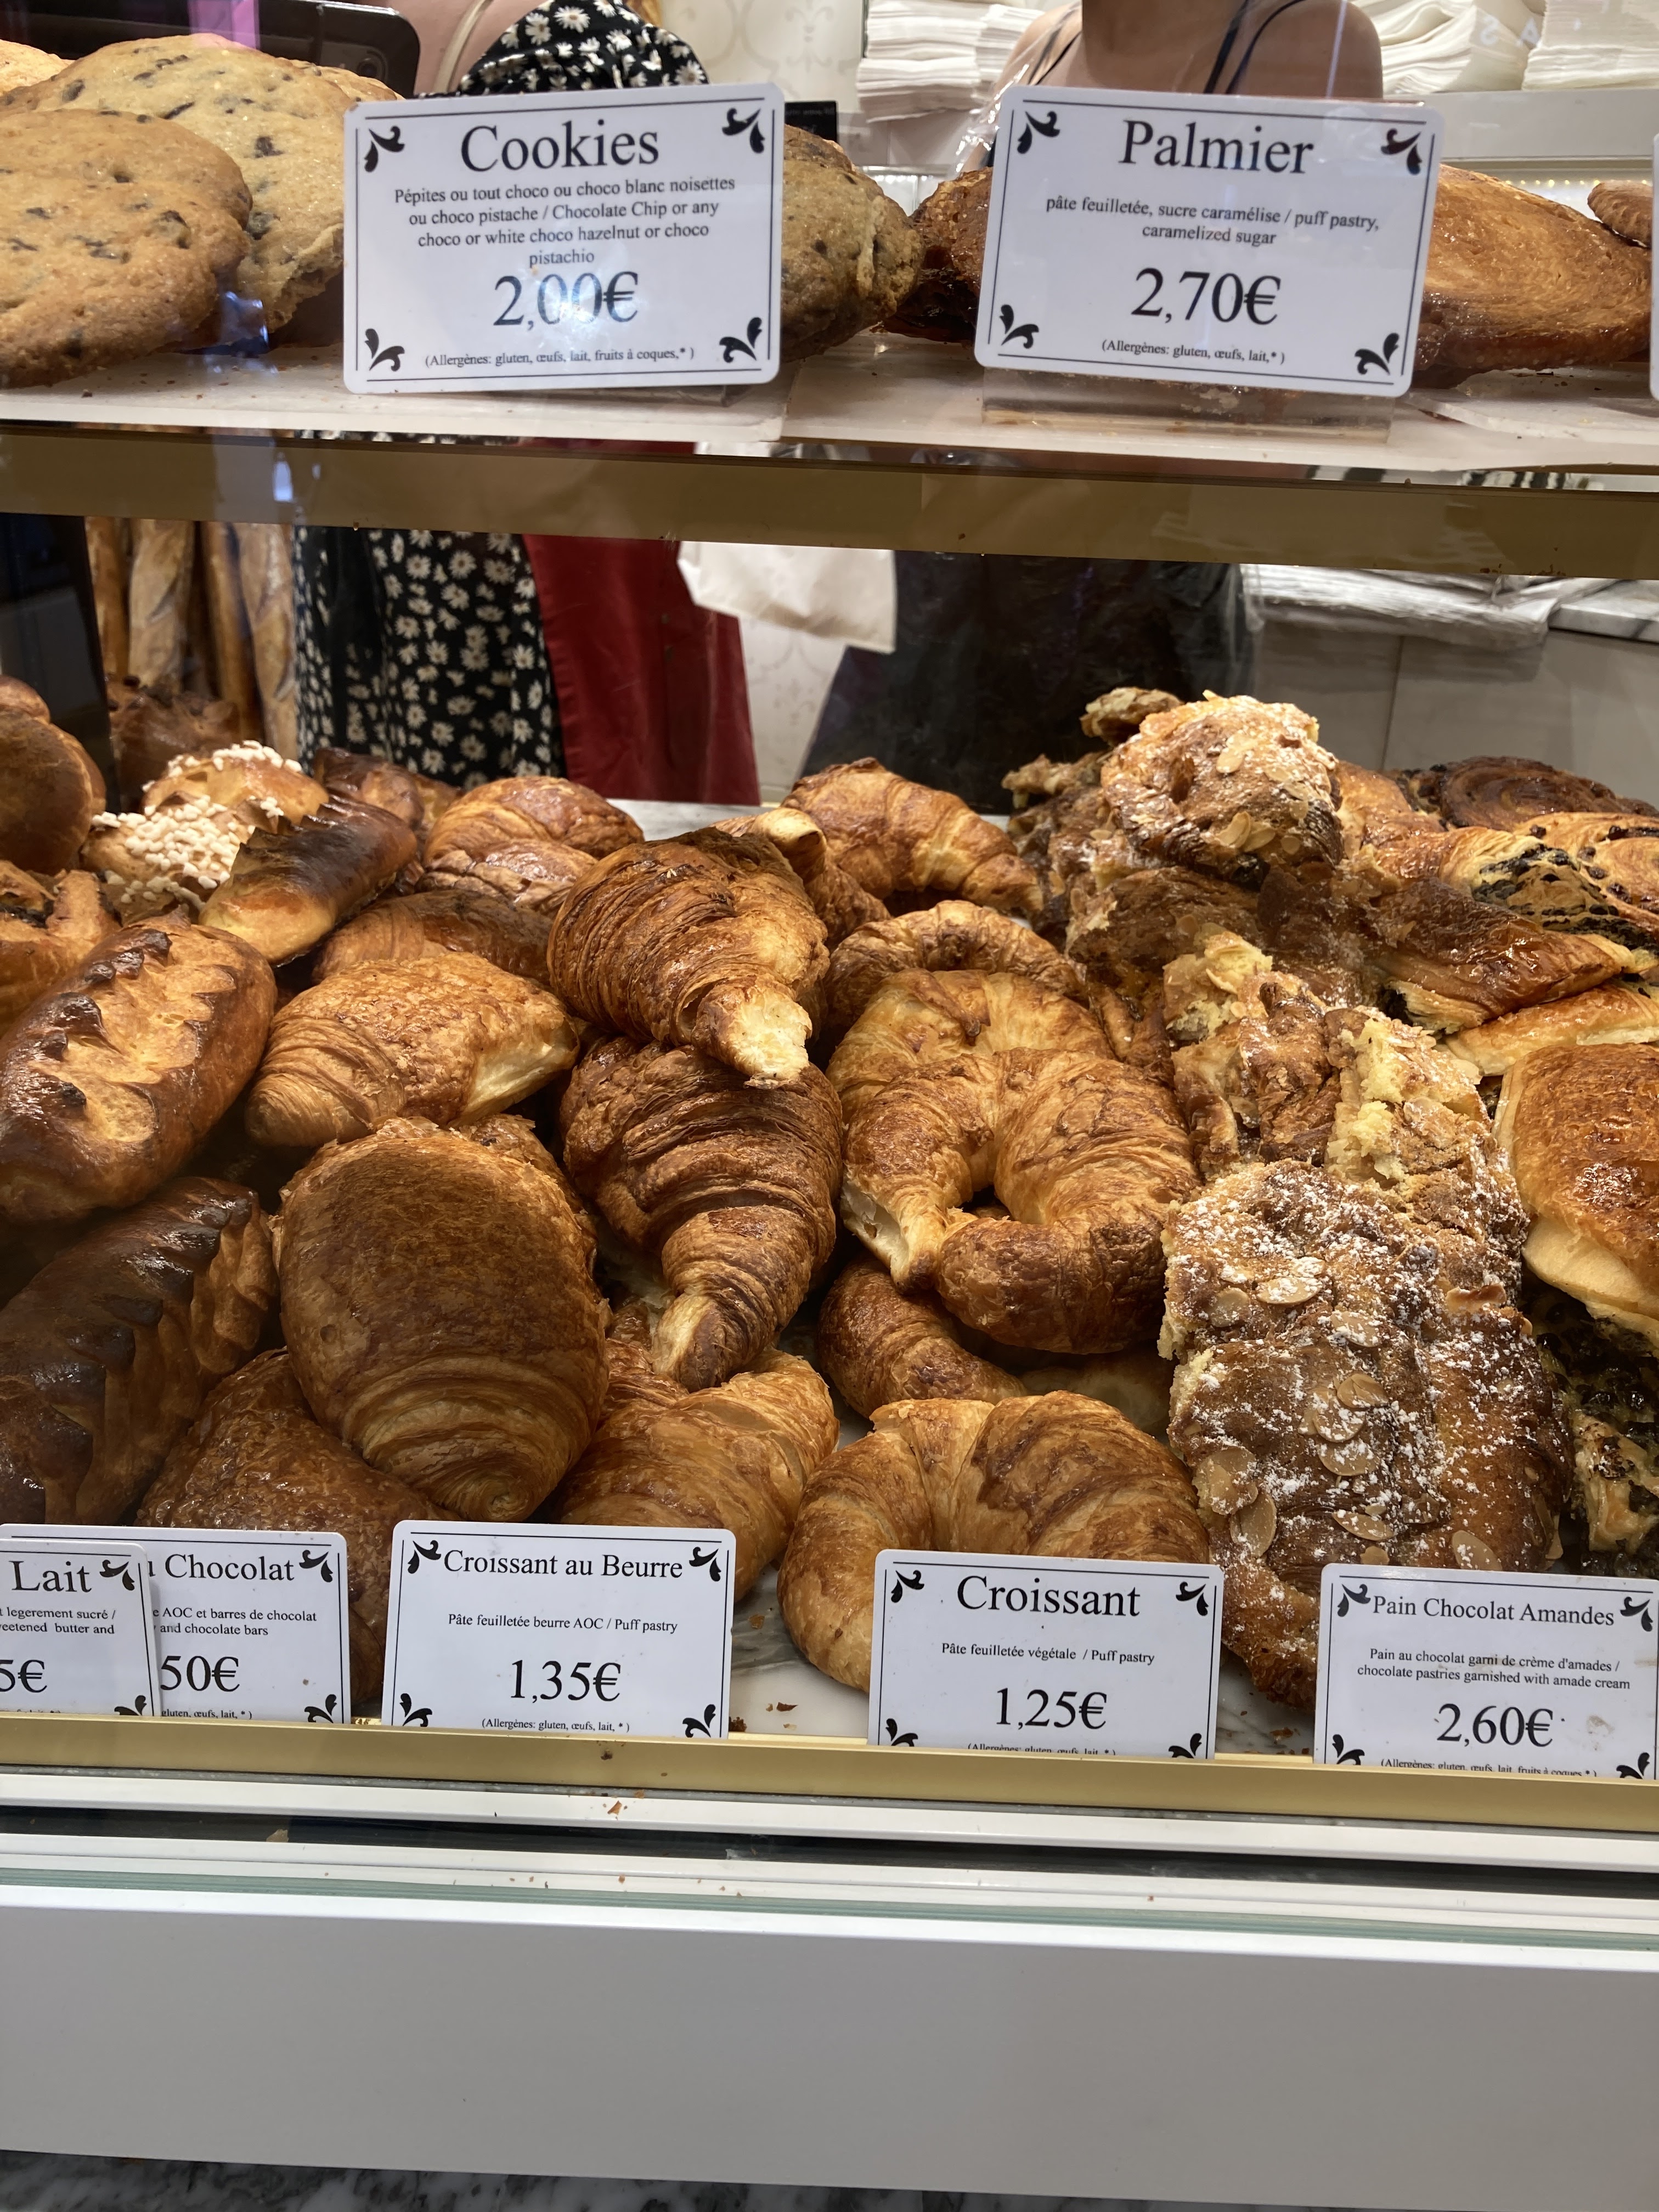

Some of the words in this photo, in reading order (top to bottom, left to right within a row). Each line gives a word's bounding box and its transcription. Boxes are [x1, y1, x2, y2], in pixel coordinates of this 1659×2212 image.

[461, 119, 658, 172] Cookies
[1119, 120, 1314, 173] Palmier
[396, 188, 445, 206] Pépites
[450, 191, 467, 201] ou
[473, 188, 500, 200] tout
[506, 184, 549, 199] choco
[554, 187, 571, 197] ou
[577, 181, 620, 196] choco
[625, 179, 664, 194] blanc
[670, 177, 735, 191] noisettes
[409, 215, 426, 225] ou
[432, 210, 474, 224] choco
[479, 207, 538, 226] pistache
[543, 205, 549, 219] /
[552, 203, 627, 219] Chocolate
[631, 201, 667, 218] Chip
[672, 204, 687, 215] or
[692, 203, 719, 217] any
[1047, 195, 1076, 212] pâte
[1082, 197, 1152, 217] feuilletée,
[1159, 206, 1197, 217] sucre
[1201, 207, 1280, 223] caramélise
[1284, 209, 1292, 223] /
[1295, 211, 1329, 227] puff
[1330, 216, 1378, 232] pastry,
[418, 233, 460, 246] choco
[466, 235, 481, 245] or
[485, 229, 524, 244] white
[530, 228, 573, 242] choco
[579, 225, 640, 240] hazelnut
[645, 228, 661, 238] or
[665, 223, 709, 237] choco
[1142, 225, 1231, 241] caramelized
[1236, 233, 1277, 247] sugar
[529, 249, 594, 269] pistachio
[493, 271, 638, 330] 2,00€
[1131, 268, 1280, 325] 2,70€
[426, 354, 491, 368] (Allergènes:
[495, 353, 533, 366] gluten,
[537, 351, 566, 362] œufs,
[571, 351, 591, 362] lait,
[595, 350, 623, 360] fruits
[627, 349, 633, 359] à
[1102, 340, 1169, 355] (Allergènes:
[1173, 345, 1210, 359] gluten,
[1215, 349, 1244, 361] œufs,
[165, 1554, 294, 1581] Chocolat
[444, 1550, 557, 1574] Croissant
[566, 1560, 593, 1575] au
[601, 1555, 682, 1578] Beurre
[9, 1561, 92, 1593] Lait
[957, 1576, 1140, 1616] Croissant
[7, 1607, 73, 1619] legerement
[77, 1610, 108, 1619] sucré
[112, 1610, 115, 1620] /
[162, 1607, 192, 1617] AOC
[196, 1610, 206, 1618] et
[211, 1609, 246, 1619] barres
[250, 1610, 263, 1620] de
[267, 1610, 317, 1621] chocolat
[1373, 1596, 1416, 1615] Pain
[1424, 1599, 1514, 1620] Chocolat
[1520, 1604, 1614, 1626] Amandes
[55, 1623, 89, 1633] butter
[94, 1625, 114, 1634] and
[160, 1623, 180, 1633] and
[185, 1623, 240, 1634] chocolate
[244, 1625, 268, 1635] bars
[449, 1614, 472, 1625] Pâte
[477, 1615, 529, 1627] feuilletée
[534, 1616, 570, 1628] beurre
[574, 1618, 603, 1629] AOC
[607, 1618, 611, 1629] /
[616, 1620, 641, 1629] Puff
[643, 1622, 677, 1634] pastry
[943, 1643, 966, 1654] Pâte
[972, 1644, 1024, 1657] feuilletée
[1028, 1647, 1076, 1661] végétale
[1083, 1649, 1088, 1660] /
[1092, 1650, 1118, 1661] Puff
[1120, 1654, 1154, 1665] pastry
[1370, 1649, 1394, 1660] Pain
[1416, 1651, 1464, 1663] chocolat
[1469, 1655, 1497, 1667] garni
[1502, 1655, 1515, 1666] de
[1519, 1656, 1554, 1668] crème
[1558, 1658, 1611, 1671] d'amades
[1615, 1661, 1620, 1672] /
[511, 1660, 620, 1703] 1,35€
[1358, 1664, 1412, 1677] chocolate
[1417, 1668, 1460, 1680] pastries
[1464, 1671, 1520, 1683] garnished
[1524, 1673, 1549, 1684] with
[1554, 1676, 1591, 1687] amade
[1595, 1680, 1629, 1689] cream
[194, 1710, 218, 1718] œufs,
[221, 1711, 238, 1719] lait,
[997, 1688, 1107, 1730] 1,25€
[482, 1719, 535, 1730] (Allergènes:
[539, 1720, 568, 1731] gluten,
[572, 1722, 595, 1731] œufs,
[599, 1722, 614, 1731] lait,
[1436, 1703, 1553, 1747] 2,60€
